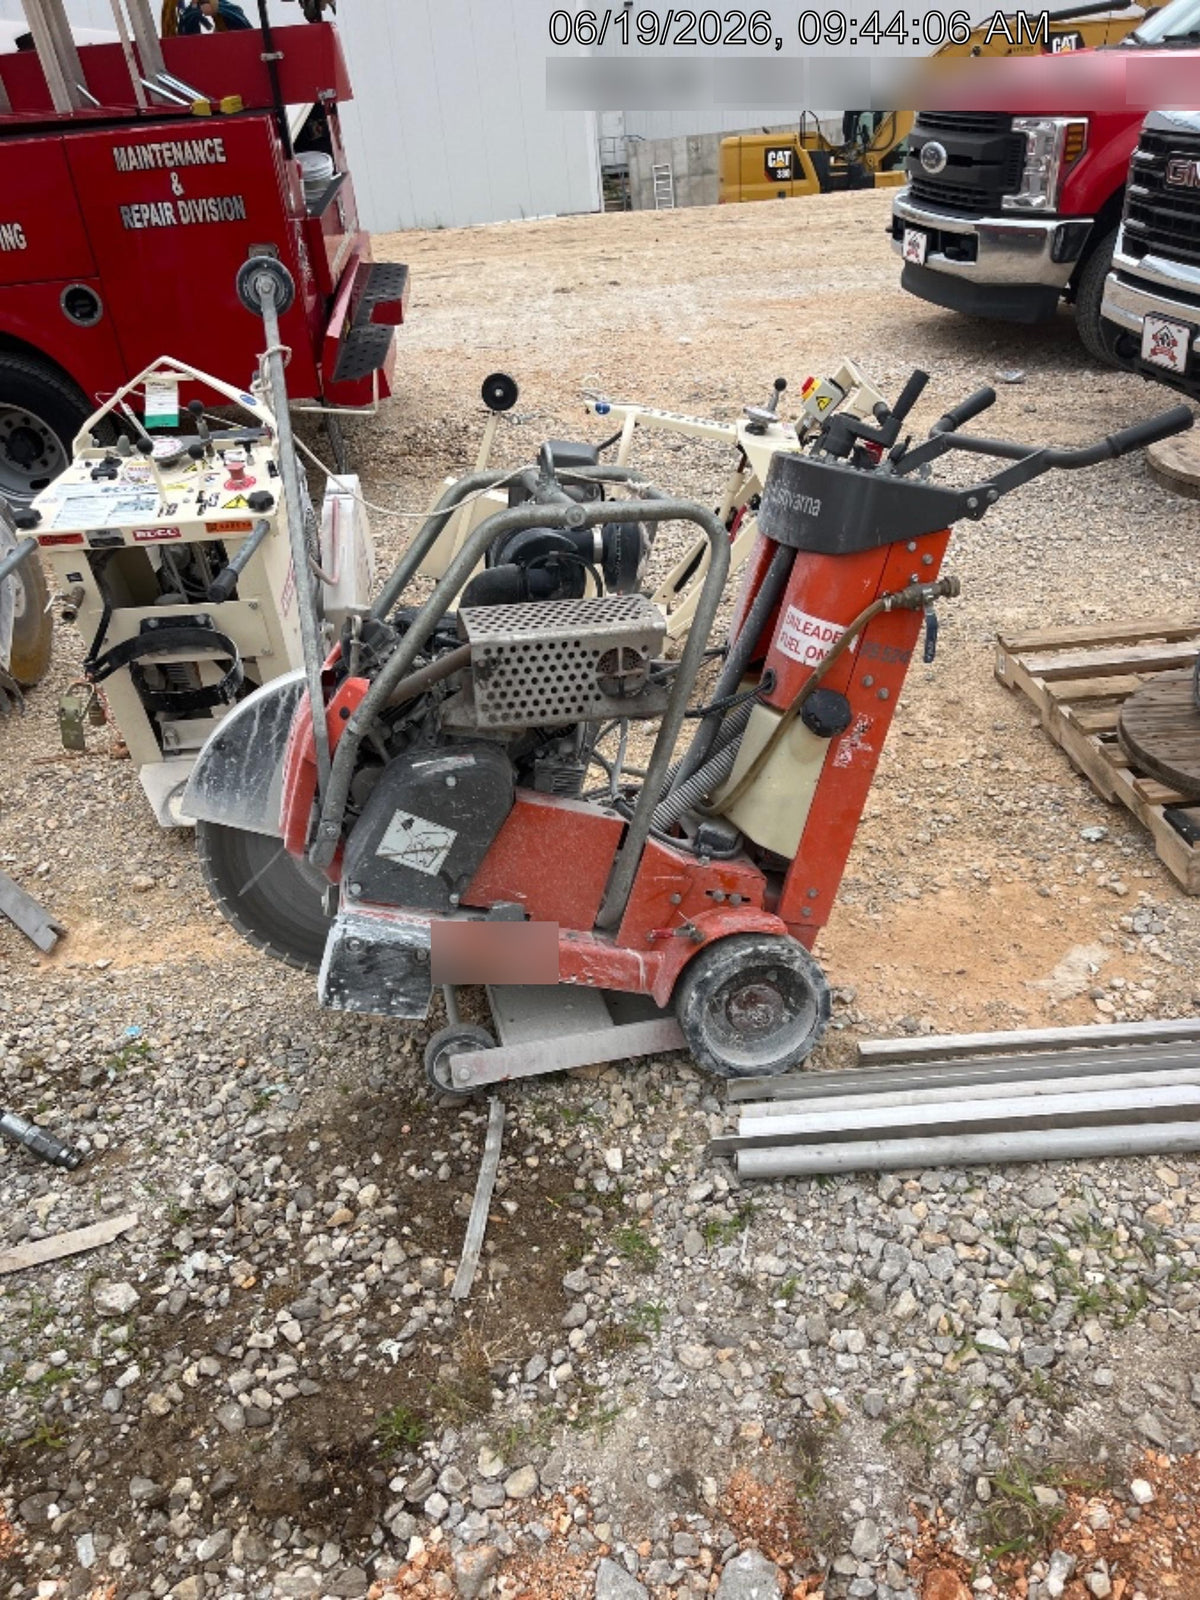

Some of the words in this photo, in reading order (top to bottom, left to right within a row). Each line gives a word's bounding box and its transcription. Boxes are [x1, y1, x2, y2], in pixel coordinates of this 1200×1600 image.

[1052, 34, 1078, 54] CAT
[113, 138, 226, 171] MAINTENANCE
[767, 150, 792, 168] CAT
[170, 172, 185, 196] &
[121, 202, 177, 229] REPAIR
[178, 196, 246, 225] DIVISION
[785, 611, 844, 645] UNLEADE
